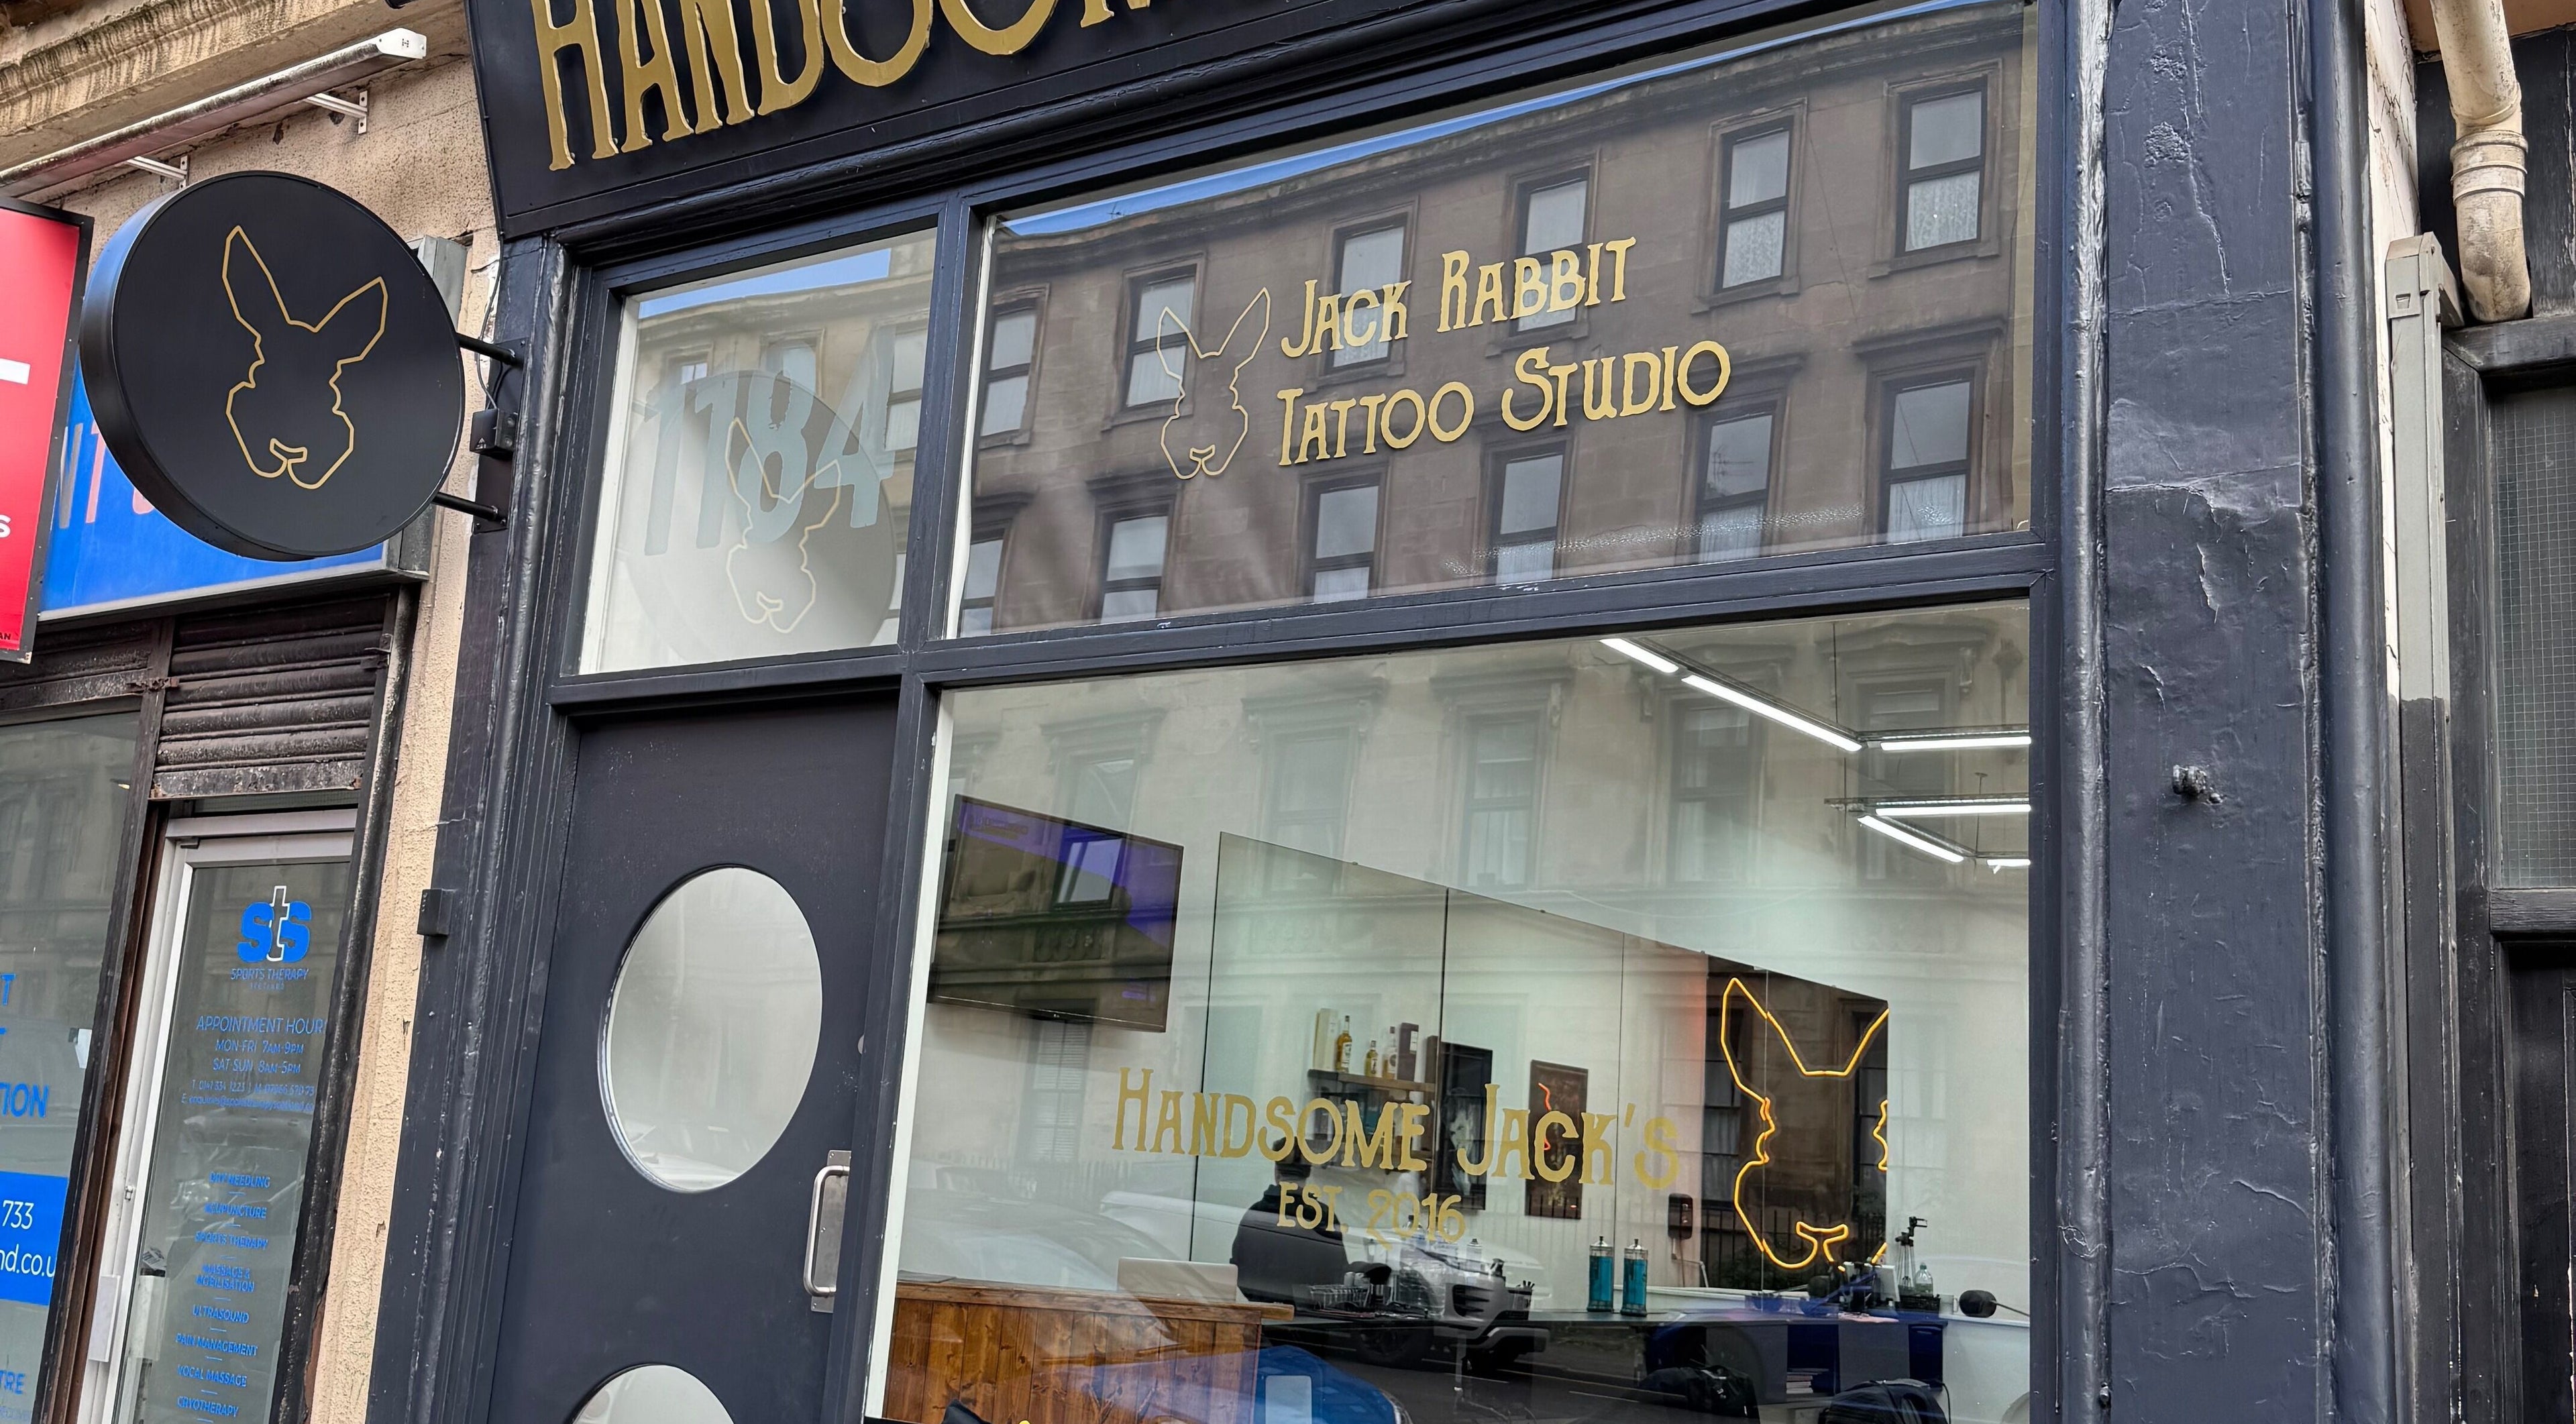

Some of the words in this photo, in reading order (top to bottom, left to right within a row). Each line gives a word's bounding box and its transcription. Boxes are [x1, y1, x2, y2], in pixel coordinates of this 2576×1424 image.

[645, 325, 896, 555] 1184
[230, 968, 266, 980] SPORTS
[267, 968, 309, 980] THERAPY
[196, 1015, 284, 1034] APPOINTMENT
[285, 1018, 328, 1034] HOUR
[1111, 1066, 1430, 1171] HANDSOME
[1457, 1083, 1681, 1190] JACK'S
[2, 1199, 34, 1229] 733
[1364, 1188, 1466, 1250] 2016
[229, 1234, 268, 1250] THERAPY
[192, 1304, 250, 1324] ULTRASOUND
[175, 1332, 196, 1346] PAIN
[197, 1335, 258, 1356] MANAGEMENT
[205, 1369, 248, 1388] MASSAGE
[176, 1395, 239, 1417] CRYOTHERAPY
